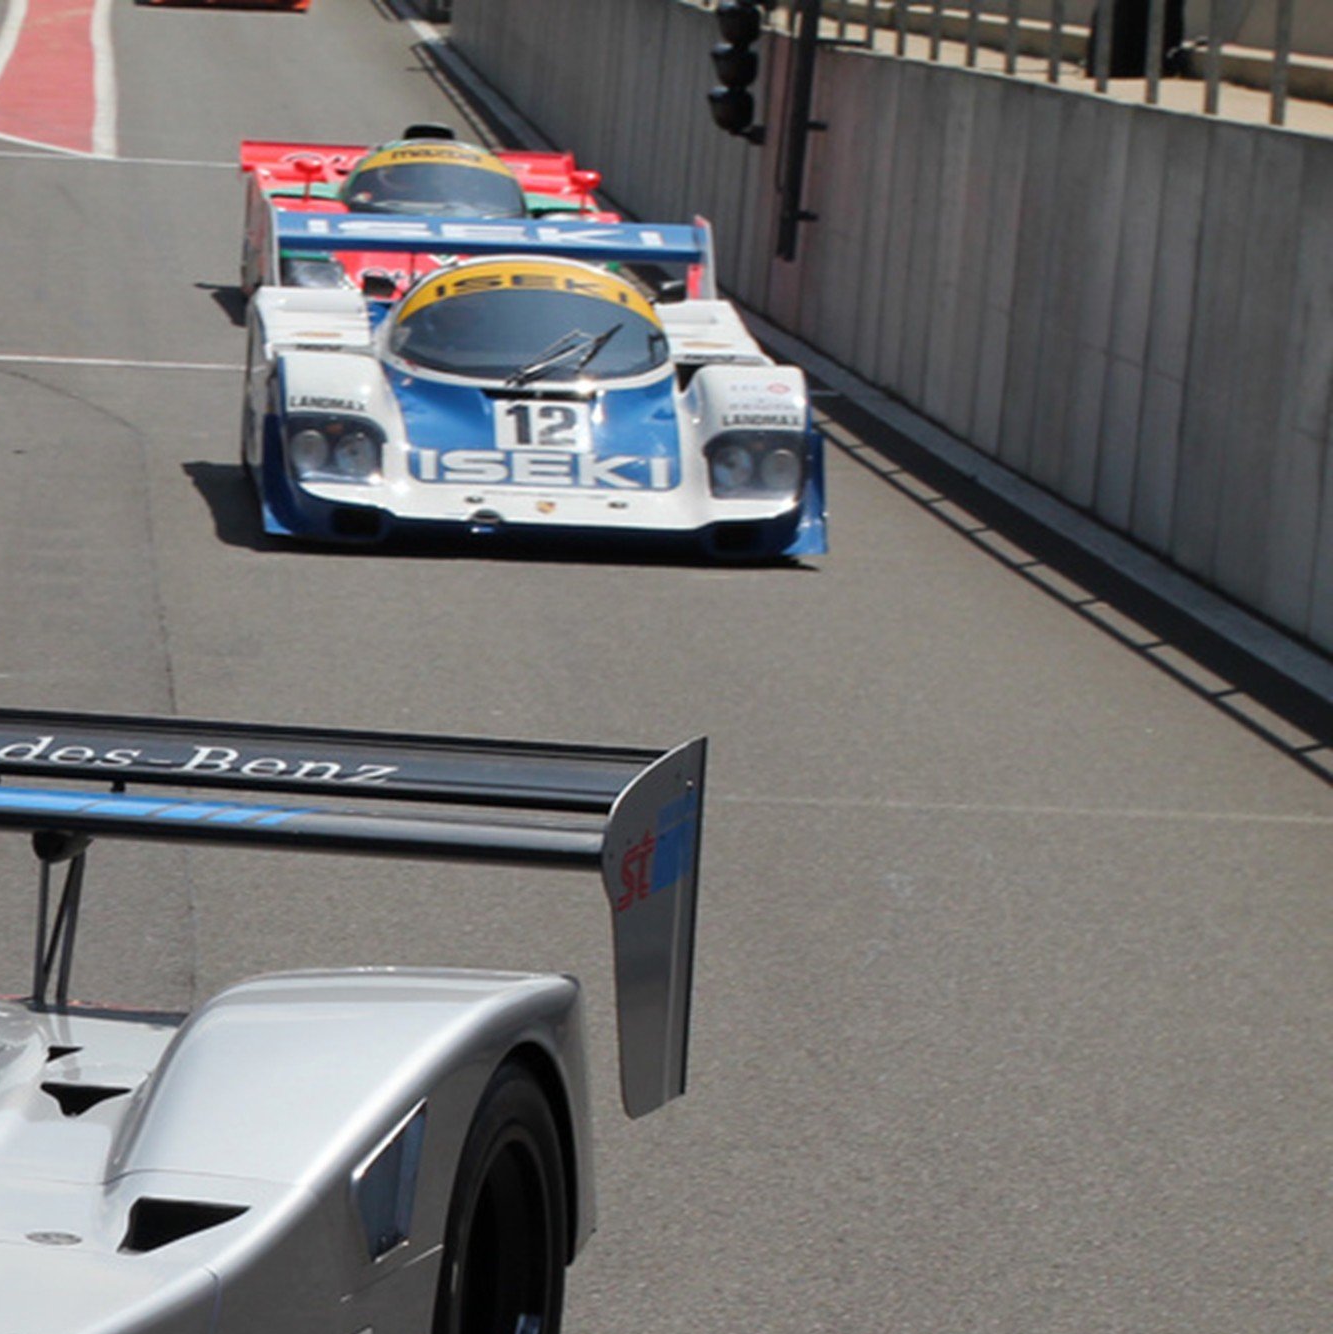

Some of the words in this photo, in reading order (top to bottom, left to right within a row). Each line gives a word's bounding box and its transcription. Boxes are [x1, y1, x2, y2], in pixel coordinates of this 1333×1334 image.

[306, 218, 665, 248] ISEKI
[435, 273, 629, 303] ISEKI
[504, 403, 577, 446] 12
[418, 449, 669, 489] ISEKI
